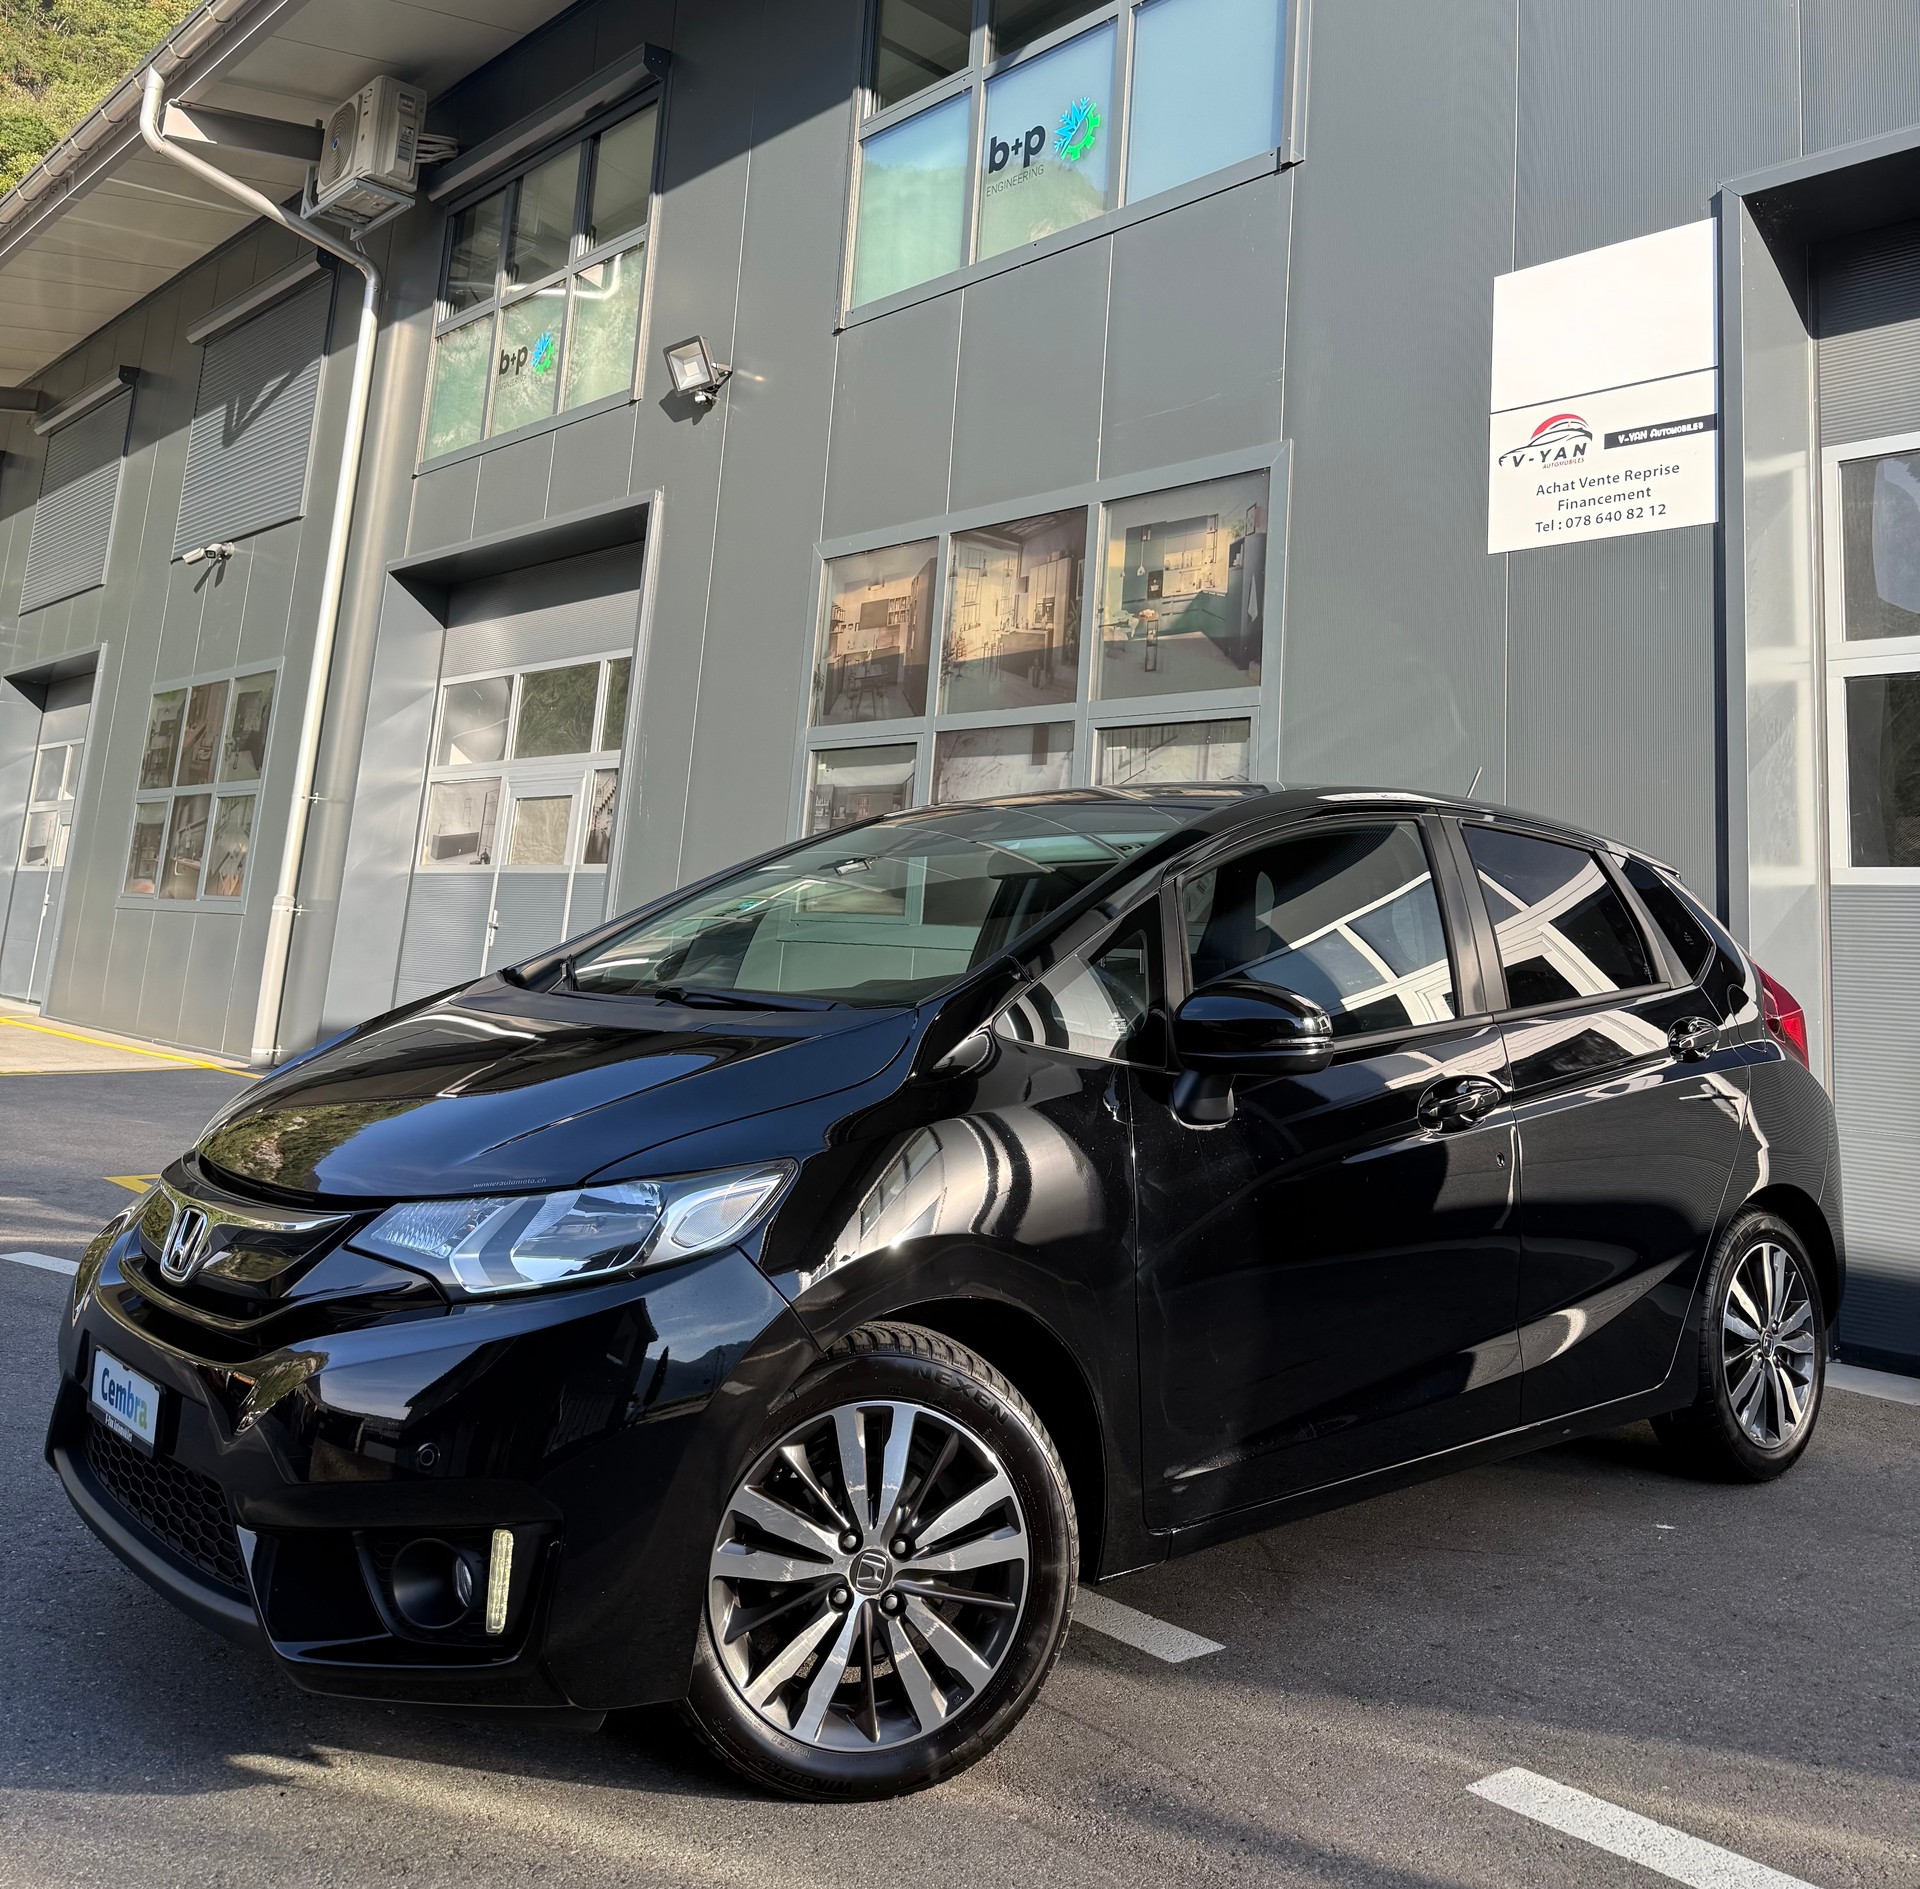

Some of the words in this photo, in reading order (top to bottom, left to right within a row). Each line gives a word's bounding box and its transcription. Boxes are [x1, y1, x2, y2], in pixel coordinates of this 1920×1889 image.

[988, 125, 1046, 174] b+p
[986, 164, 1045, 197] ENGINEERING
[499, 346, 528, 376] b+p
[1618, 429, 1648, 444] V-YAN
[1512, 442, 1587, 468] V-YAN
[1542, 457, 1585, 469] AUTOMOBILES
[1536, 480, 1576, 496] Achat
[1579, 473, 1620, 488] Vente
[1624, 463, 1680, 481] Reprise
[1557, 487, 1652, 511] Financement
[1565, 515, 1592, 529] 078
[1595, 510, 1622, 525] 640
[1626, 506, 1644, 520] 82
[1649, 503, 1666, 517] 12
[101, 1367, 148, 1430] Cembra
[912, 1364, 1010, 1425] NEXEN
